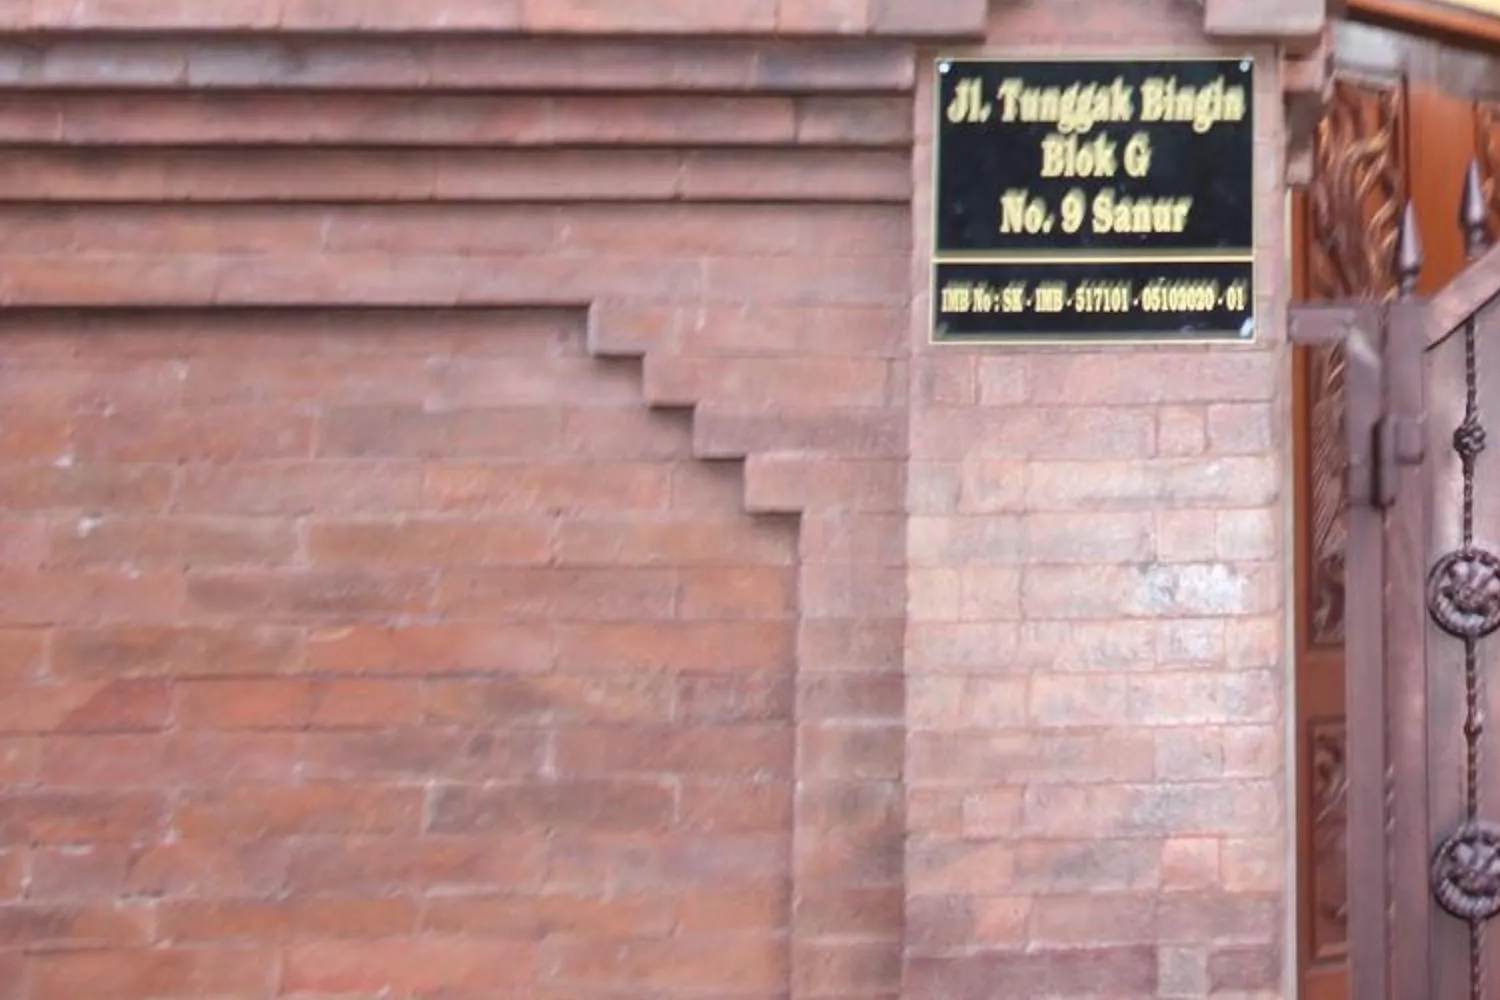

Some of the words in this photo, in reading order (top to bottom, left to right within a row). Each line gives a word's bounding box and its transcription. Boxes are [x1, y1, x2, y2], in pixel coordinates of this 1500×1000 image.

[947, 78, 991, 122] Jl.
[997, 77, 1133, 132] Tunggak
[1140, 76, 1245, 132] Bingin
[1040, 133, 1118, 177] Blok
[1123, 132, 1152, 177] G
[1000, 188, 1054, 233] No.
[1060, 188, 1086, 233] 9
[1092, 187, 1193, 233] Sanur
